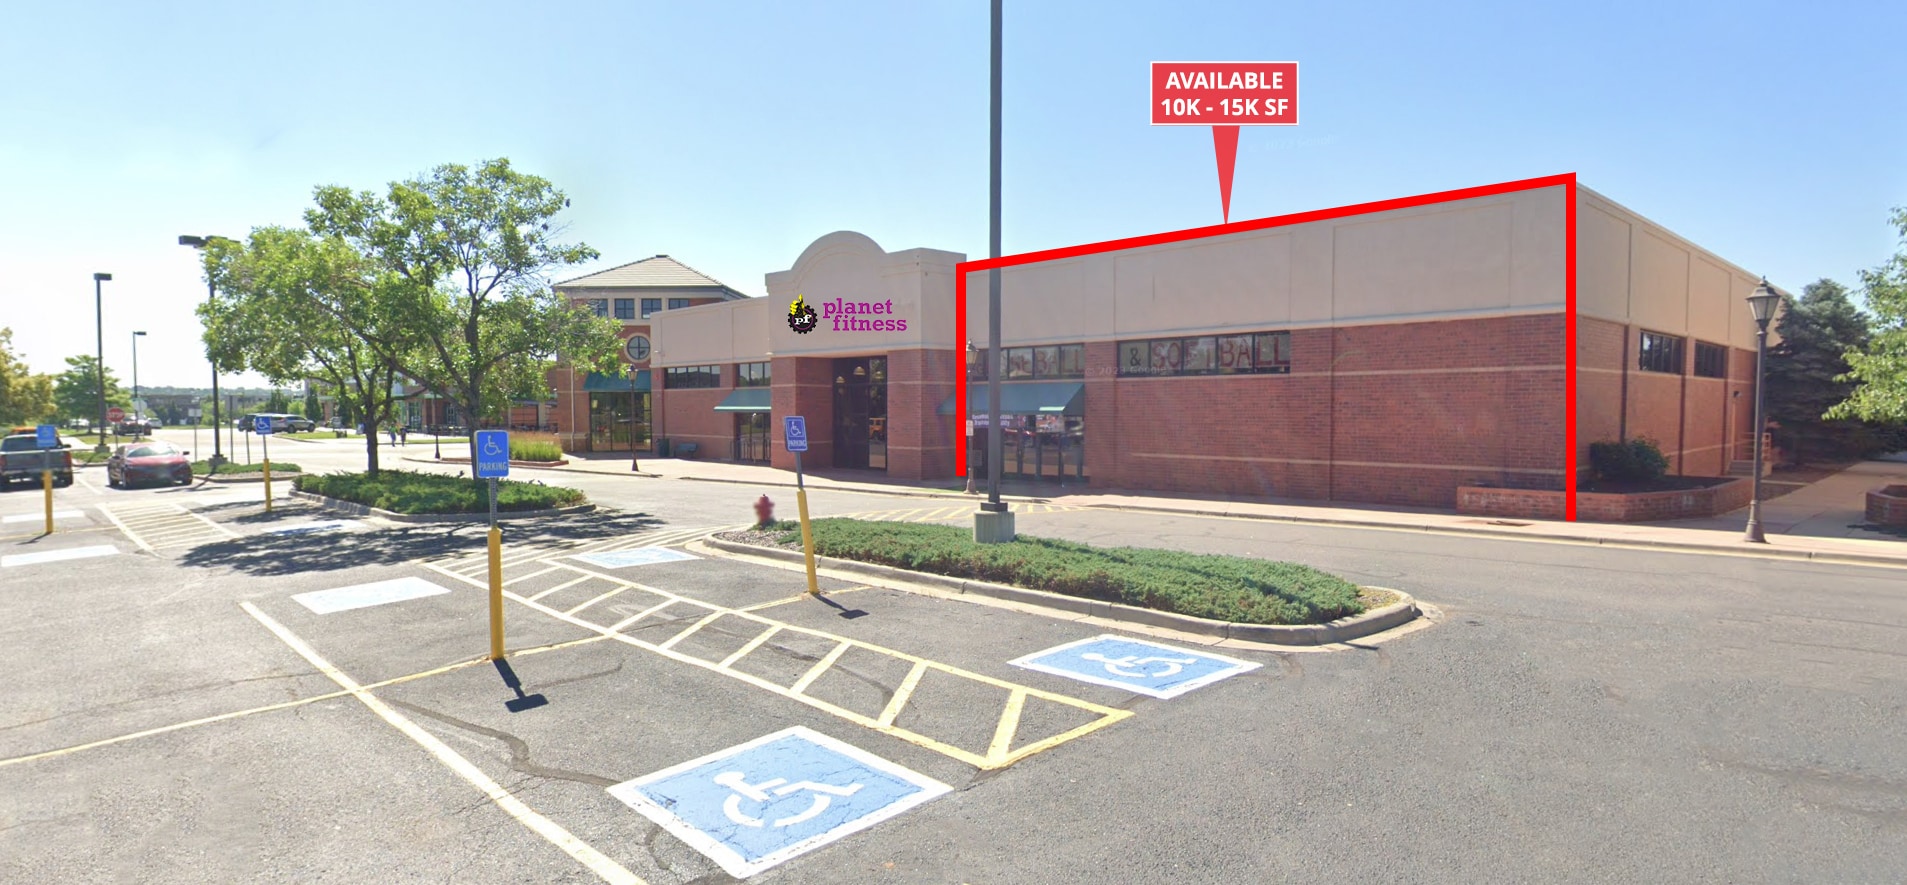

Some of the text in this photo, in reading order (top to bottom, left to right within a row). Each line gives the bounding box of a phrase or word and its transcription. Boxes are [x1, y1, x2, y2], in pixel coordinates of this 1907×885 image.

[822, 297, 893, 319] planet
[794, 314, 812, 325] pf
[832, 314, 908, 331] fitness
[1129, 347, 1142, 367] &
[1152, 335, 1291, 369] SOFTBALL
[479, 461, 507, 471] PARKING
